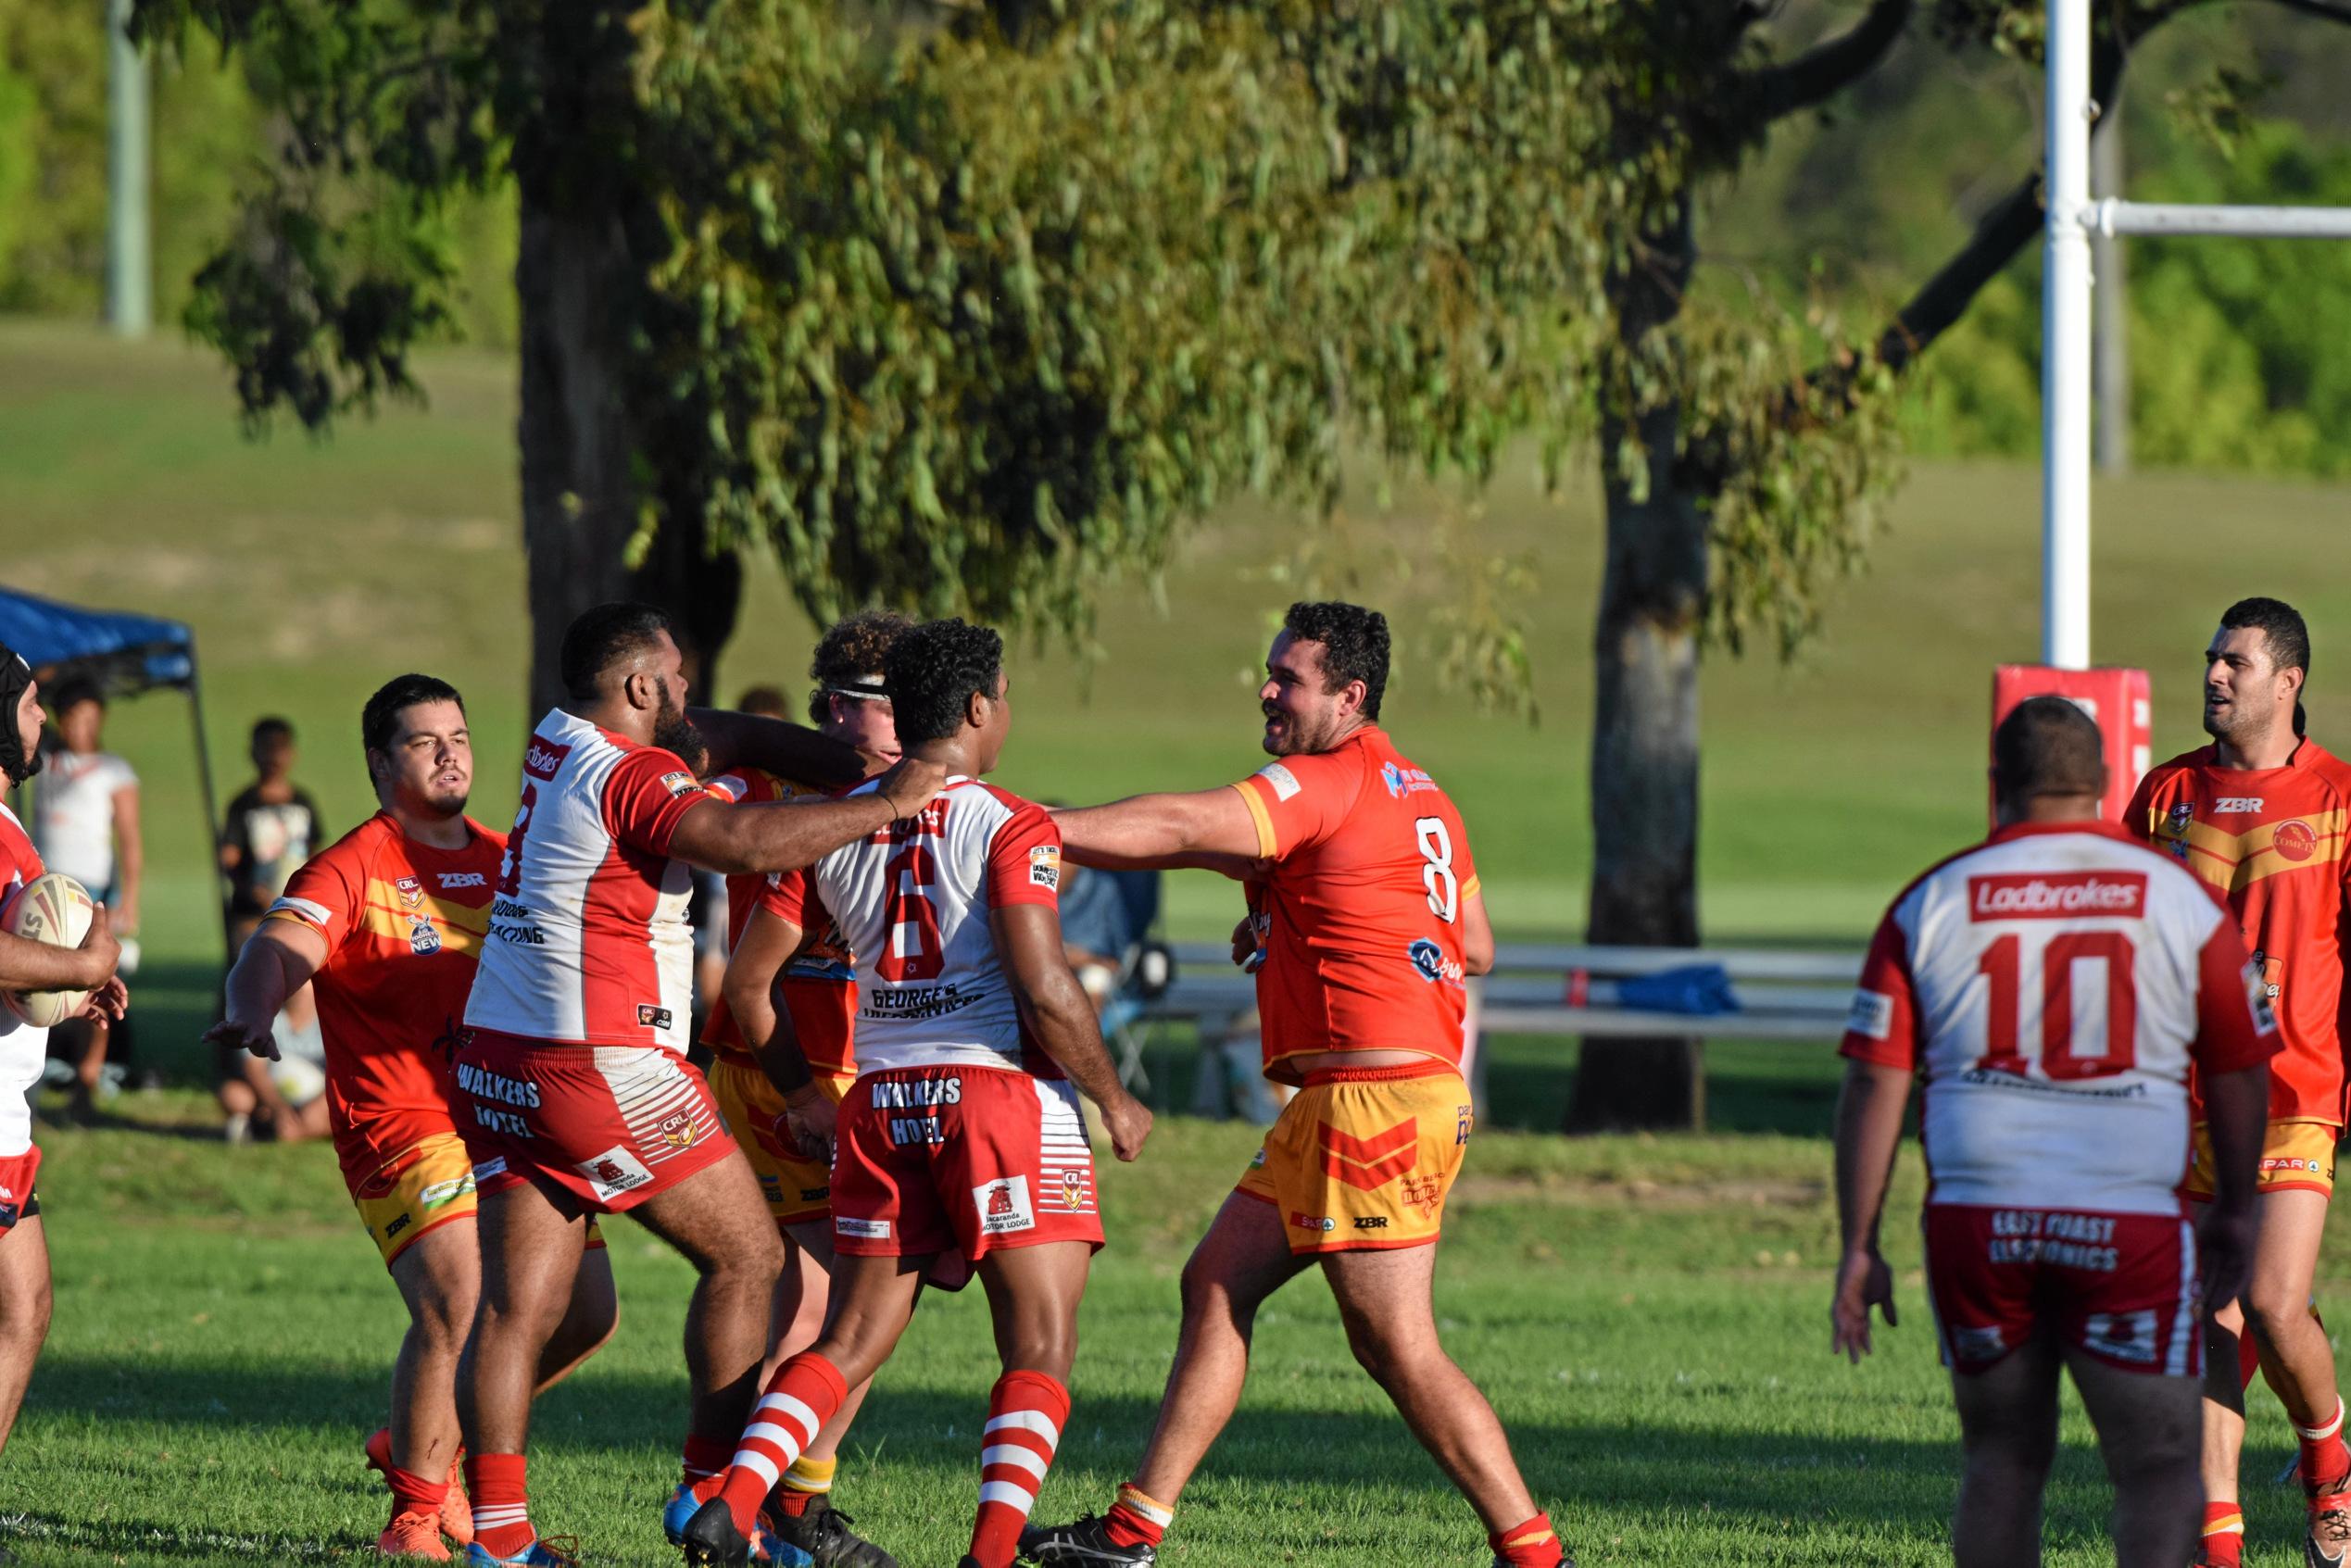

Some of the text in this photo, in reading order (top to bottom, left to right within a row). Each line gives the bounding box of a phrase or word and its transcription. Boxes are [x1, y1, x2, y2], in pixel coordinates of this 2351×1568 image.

[2214, 797, 2264, 813] ZBR
[2273, 834, 2316, 853] COMETS
[1415, 816, 1457, 924] 8
[398, 879, 419, 890] CRL
[437, 872, 487, 888] ZBR
[1976, 878, 2140, 913] Ladbrokes
[874, 844, 945, 982] 6
[412, 935, 442, 952] NEW
[871, 982, 958, 1009] GEORGE'S
[1978, 931, 2137, 1082] 10
[458, 1062, 541, 1109] WALKERS
[873, 1077, 962, 1109] WALKERS
[662, 1113, 689, 1132] CRL
[2259, 1159, 2305, 1170] PAR
[626, 1173, 648, 1188] LODGE
[385, 1211, 411, 1239] ZBR
[1007, 1217, 1031, 1229] LODGE
[1352, 1215, 1389, 1229] ZBR
